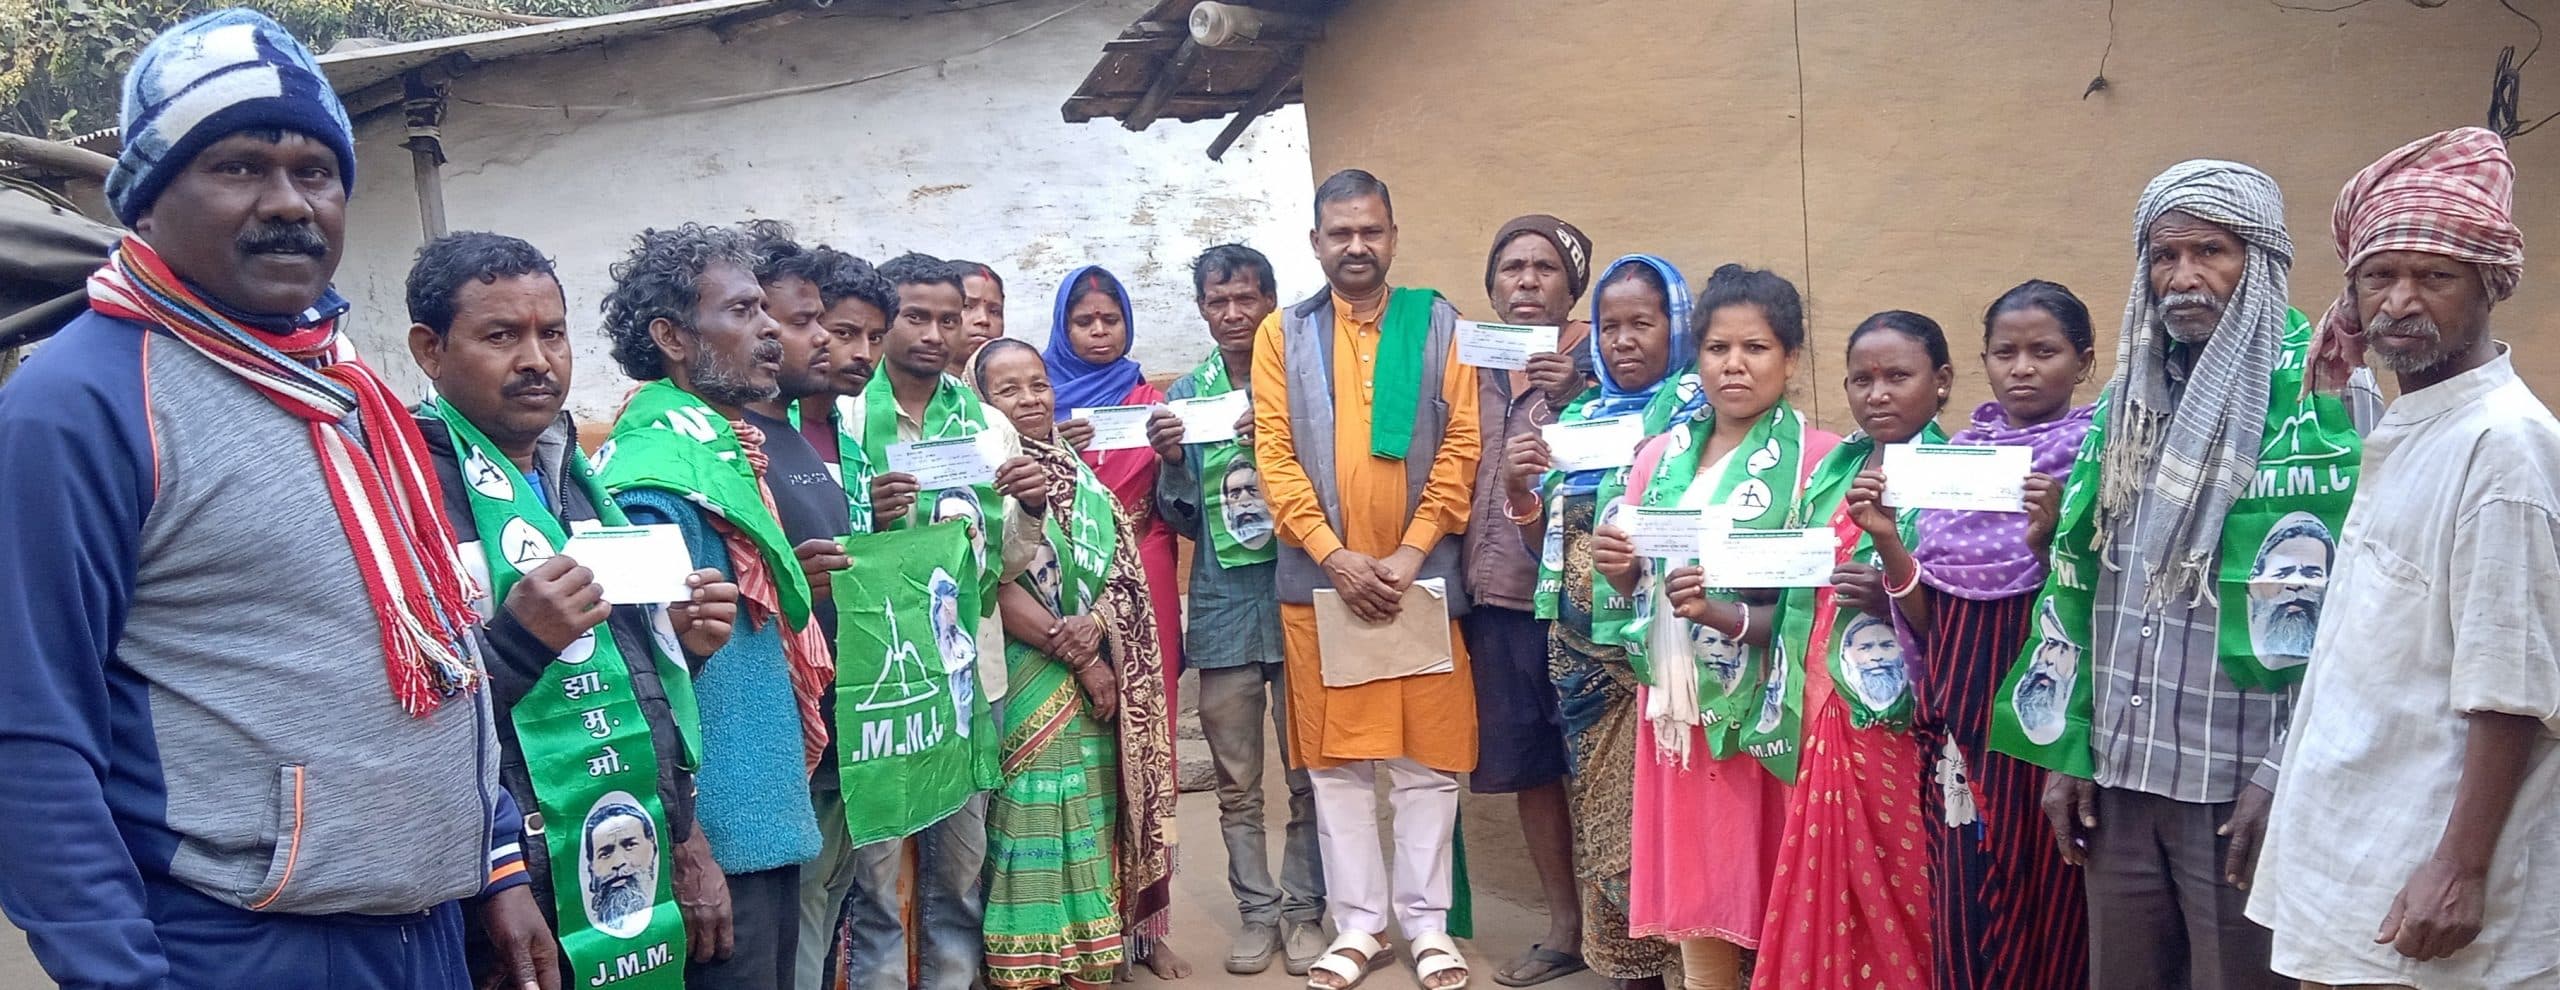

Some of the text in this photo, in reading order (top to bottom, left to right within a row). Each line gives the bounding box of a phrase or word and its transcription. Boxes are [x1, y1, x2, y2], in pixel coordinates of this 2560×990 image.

[561, 670, 610, 700] झा.
[581, 706, 620, 738] मु.
[586, 746, 630, 778] मो.
[590, 942, 674, 987] J.M.M.
